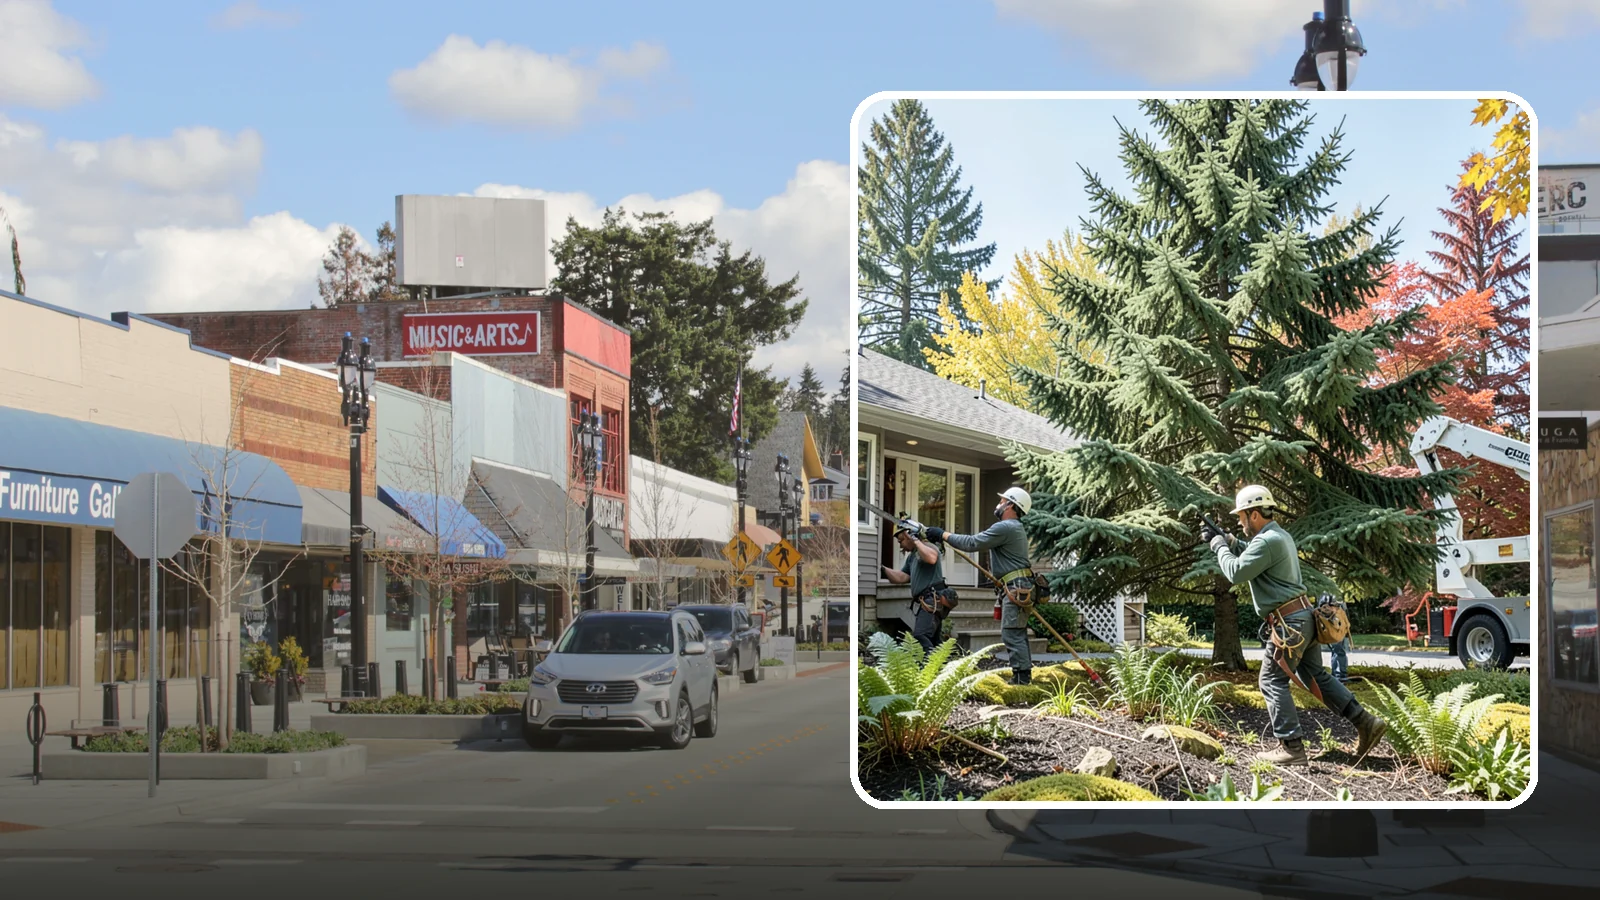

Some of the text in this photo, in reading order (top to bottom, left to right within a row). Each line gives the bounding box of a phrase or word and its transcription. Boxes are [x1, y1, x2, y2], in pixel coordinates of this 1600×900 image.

[0, 471, 121, 519] Furniture Gal
[453, 563, 479, 574] SUSHI
